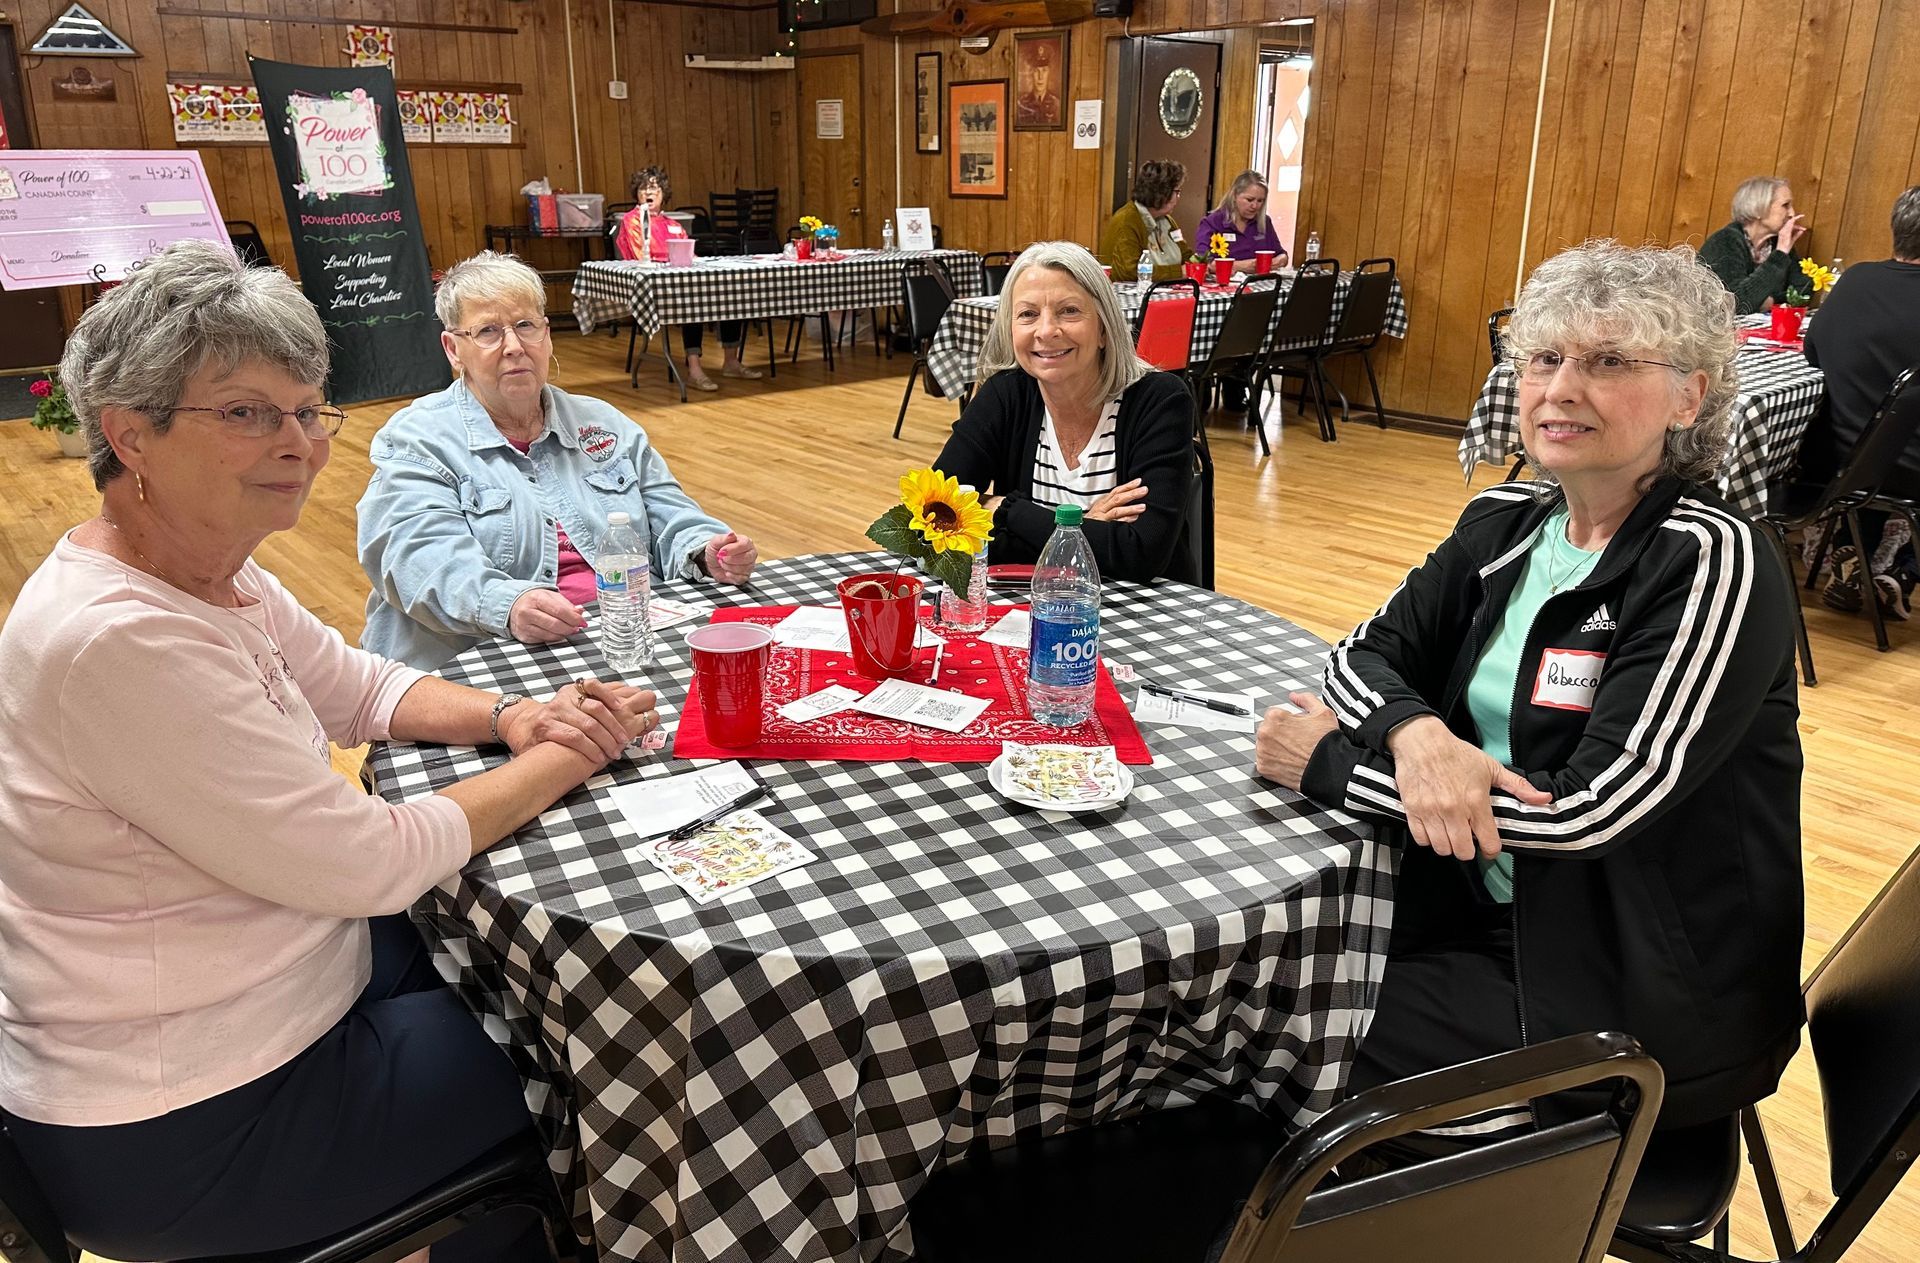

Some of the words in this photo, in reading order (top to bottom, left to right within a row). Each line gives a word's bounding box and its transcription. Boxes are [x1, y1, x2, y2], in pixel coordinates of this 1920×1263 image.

[300, 116, 371, 146] Power
[320, 154, 367, 177] 100
[19, 170, 54, 185] Power
[56, 170, 65, 188] of
[68, 170, 89, 183] 100
[25, 190, 66, 198] CANADIAN
[67, 190, 96, 198] COUNTY
[300, 210, 402, 226] powerof100cc.org
[51, 250, 89, 263] Donation
[323, 254, 350, 270] Local
[351, 252, 391, 268] Women
[334, 273, 387, 292] Supporting
[330, 294, 356, 309] Local
[359, 289, 402, 308] Charities
[1581, 620, 1617, 632] adidas
[1050, 661, 1088, 669] RECYCLED
[1547, 662, 1598, 687] Rebecca
[654, 839, 730, 872] Oklahoma
